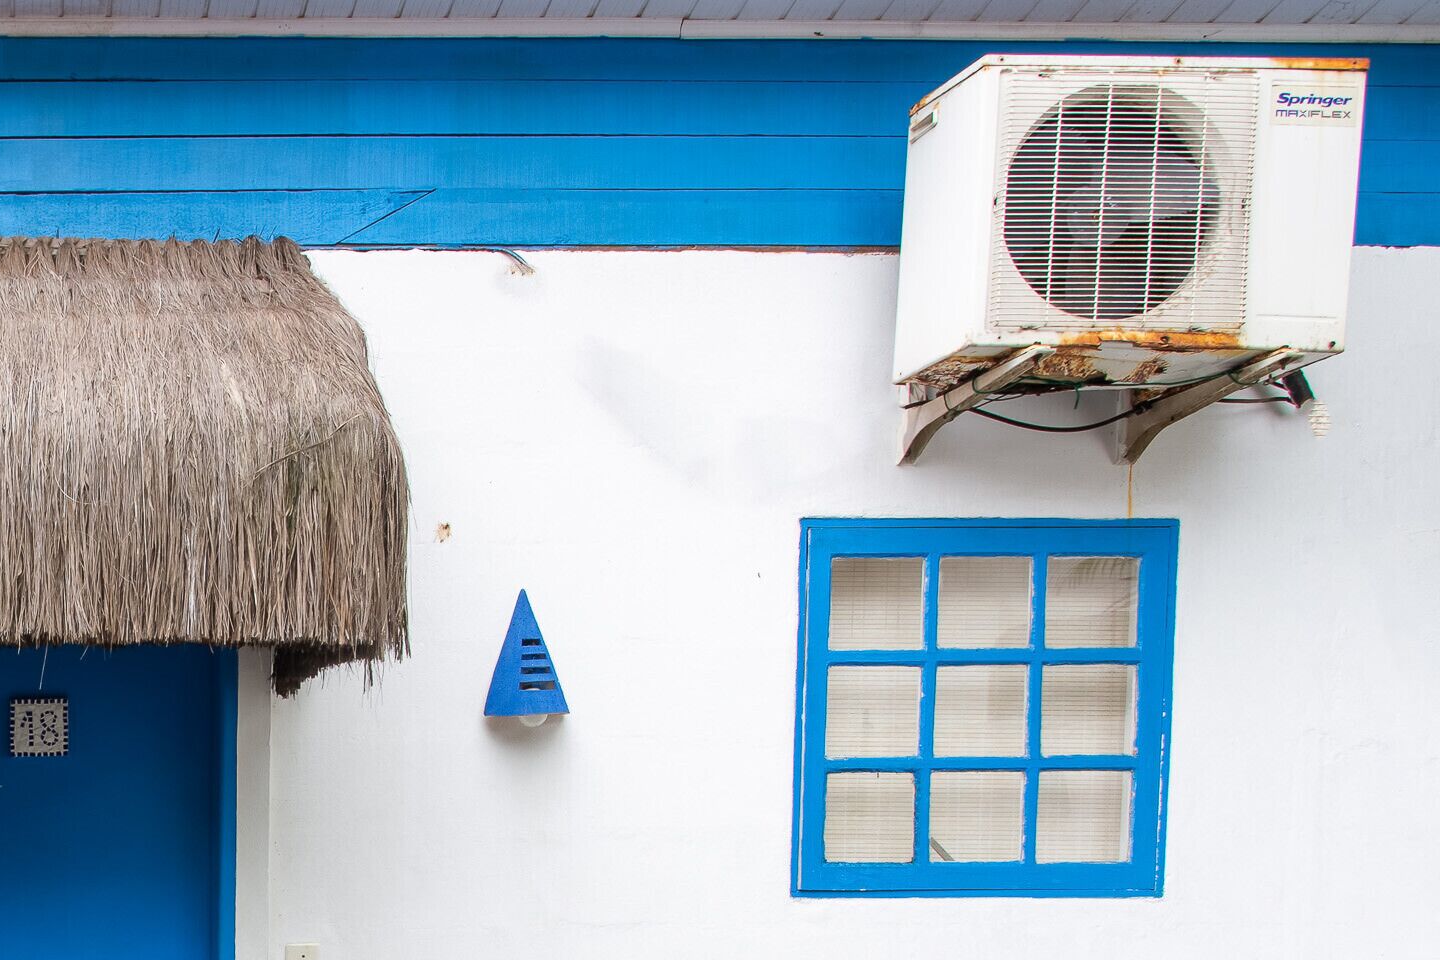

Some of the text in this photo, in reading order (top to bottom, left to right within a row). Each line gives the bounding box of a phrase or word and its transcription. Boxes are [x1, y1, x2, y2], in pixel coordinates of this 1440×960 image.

[1277, 92, 1353, 107] Springer
[1275, 109, 1351, 119] MAXIFLEX
[20, 710, 59, 747] 18
